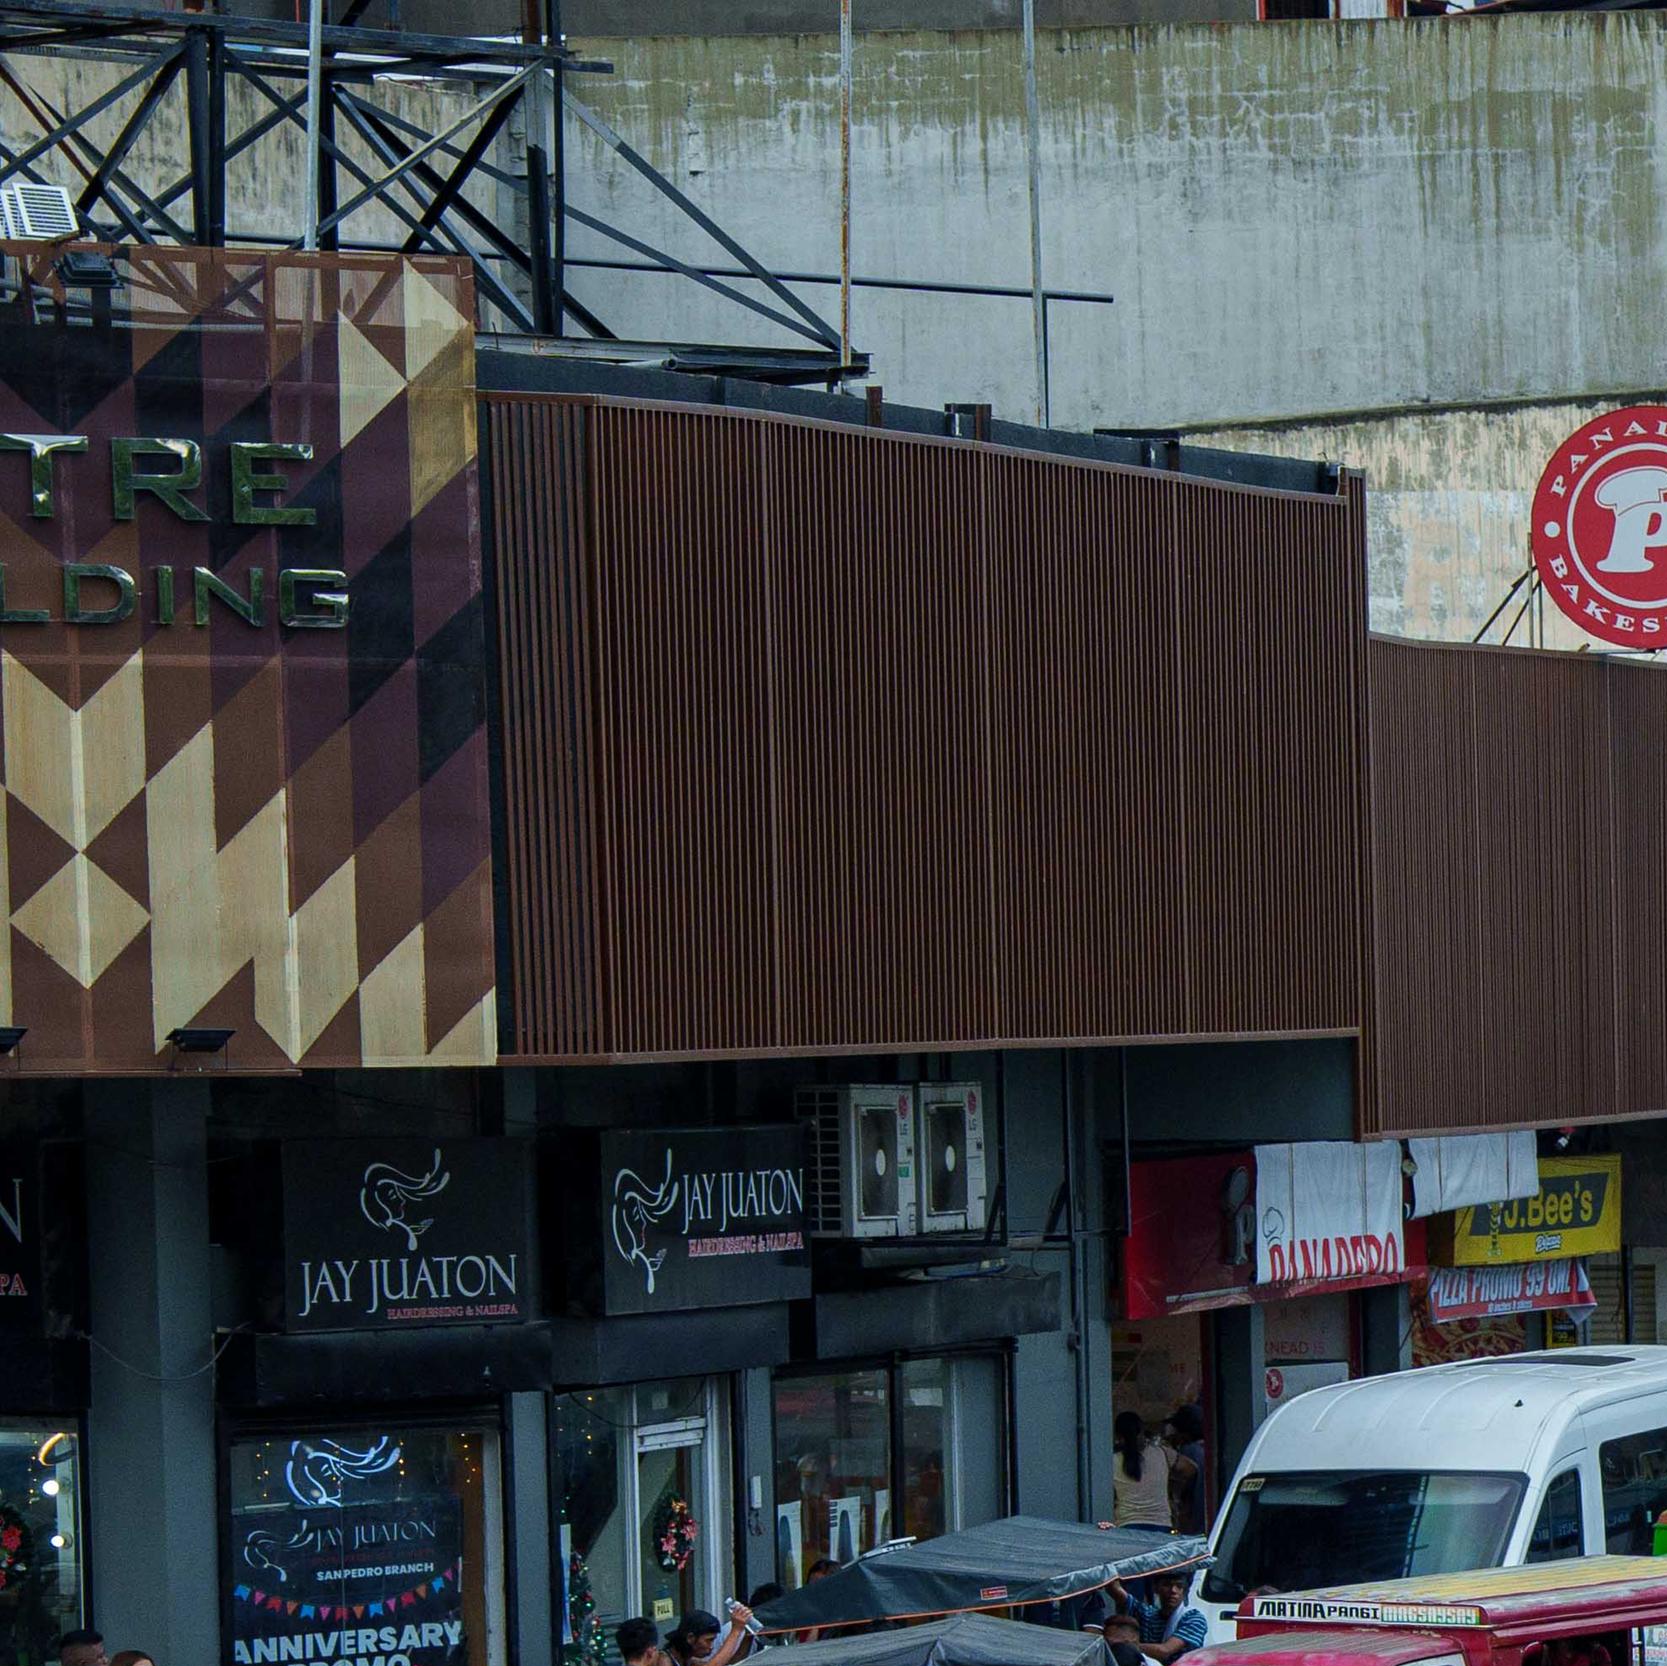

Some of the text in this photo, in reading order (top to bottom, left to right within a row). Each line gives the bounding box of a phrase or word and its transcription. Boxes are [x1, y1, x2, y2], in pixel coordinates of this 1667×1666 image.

[680, 1168, 804, 1235] JAY JUATON
[299, 1253, 518, 1317] JAY JUATON
[316, 1562, 435, 1582] SAN PEDRO BRANCH
[1258, 1601, 1327, 1619] MATINA
[235, 1620, 462, 1665] ANNIVERSARY
